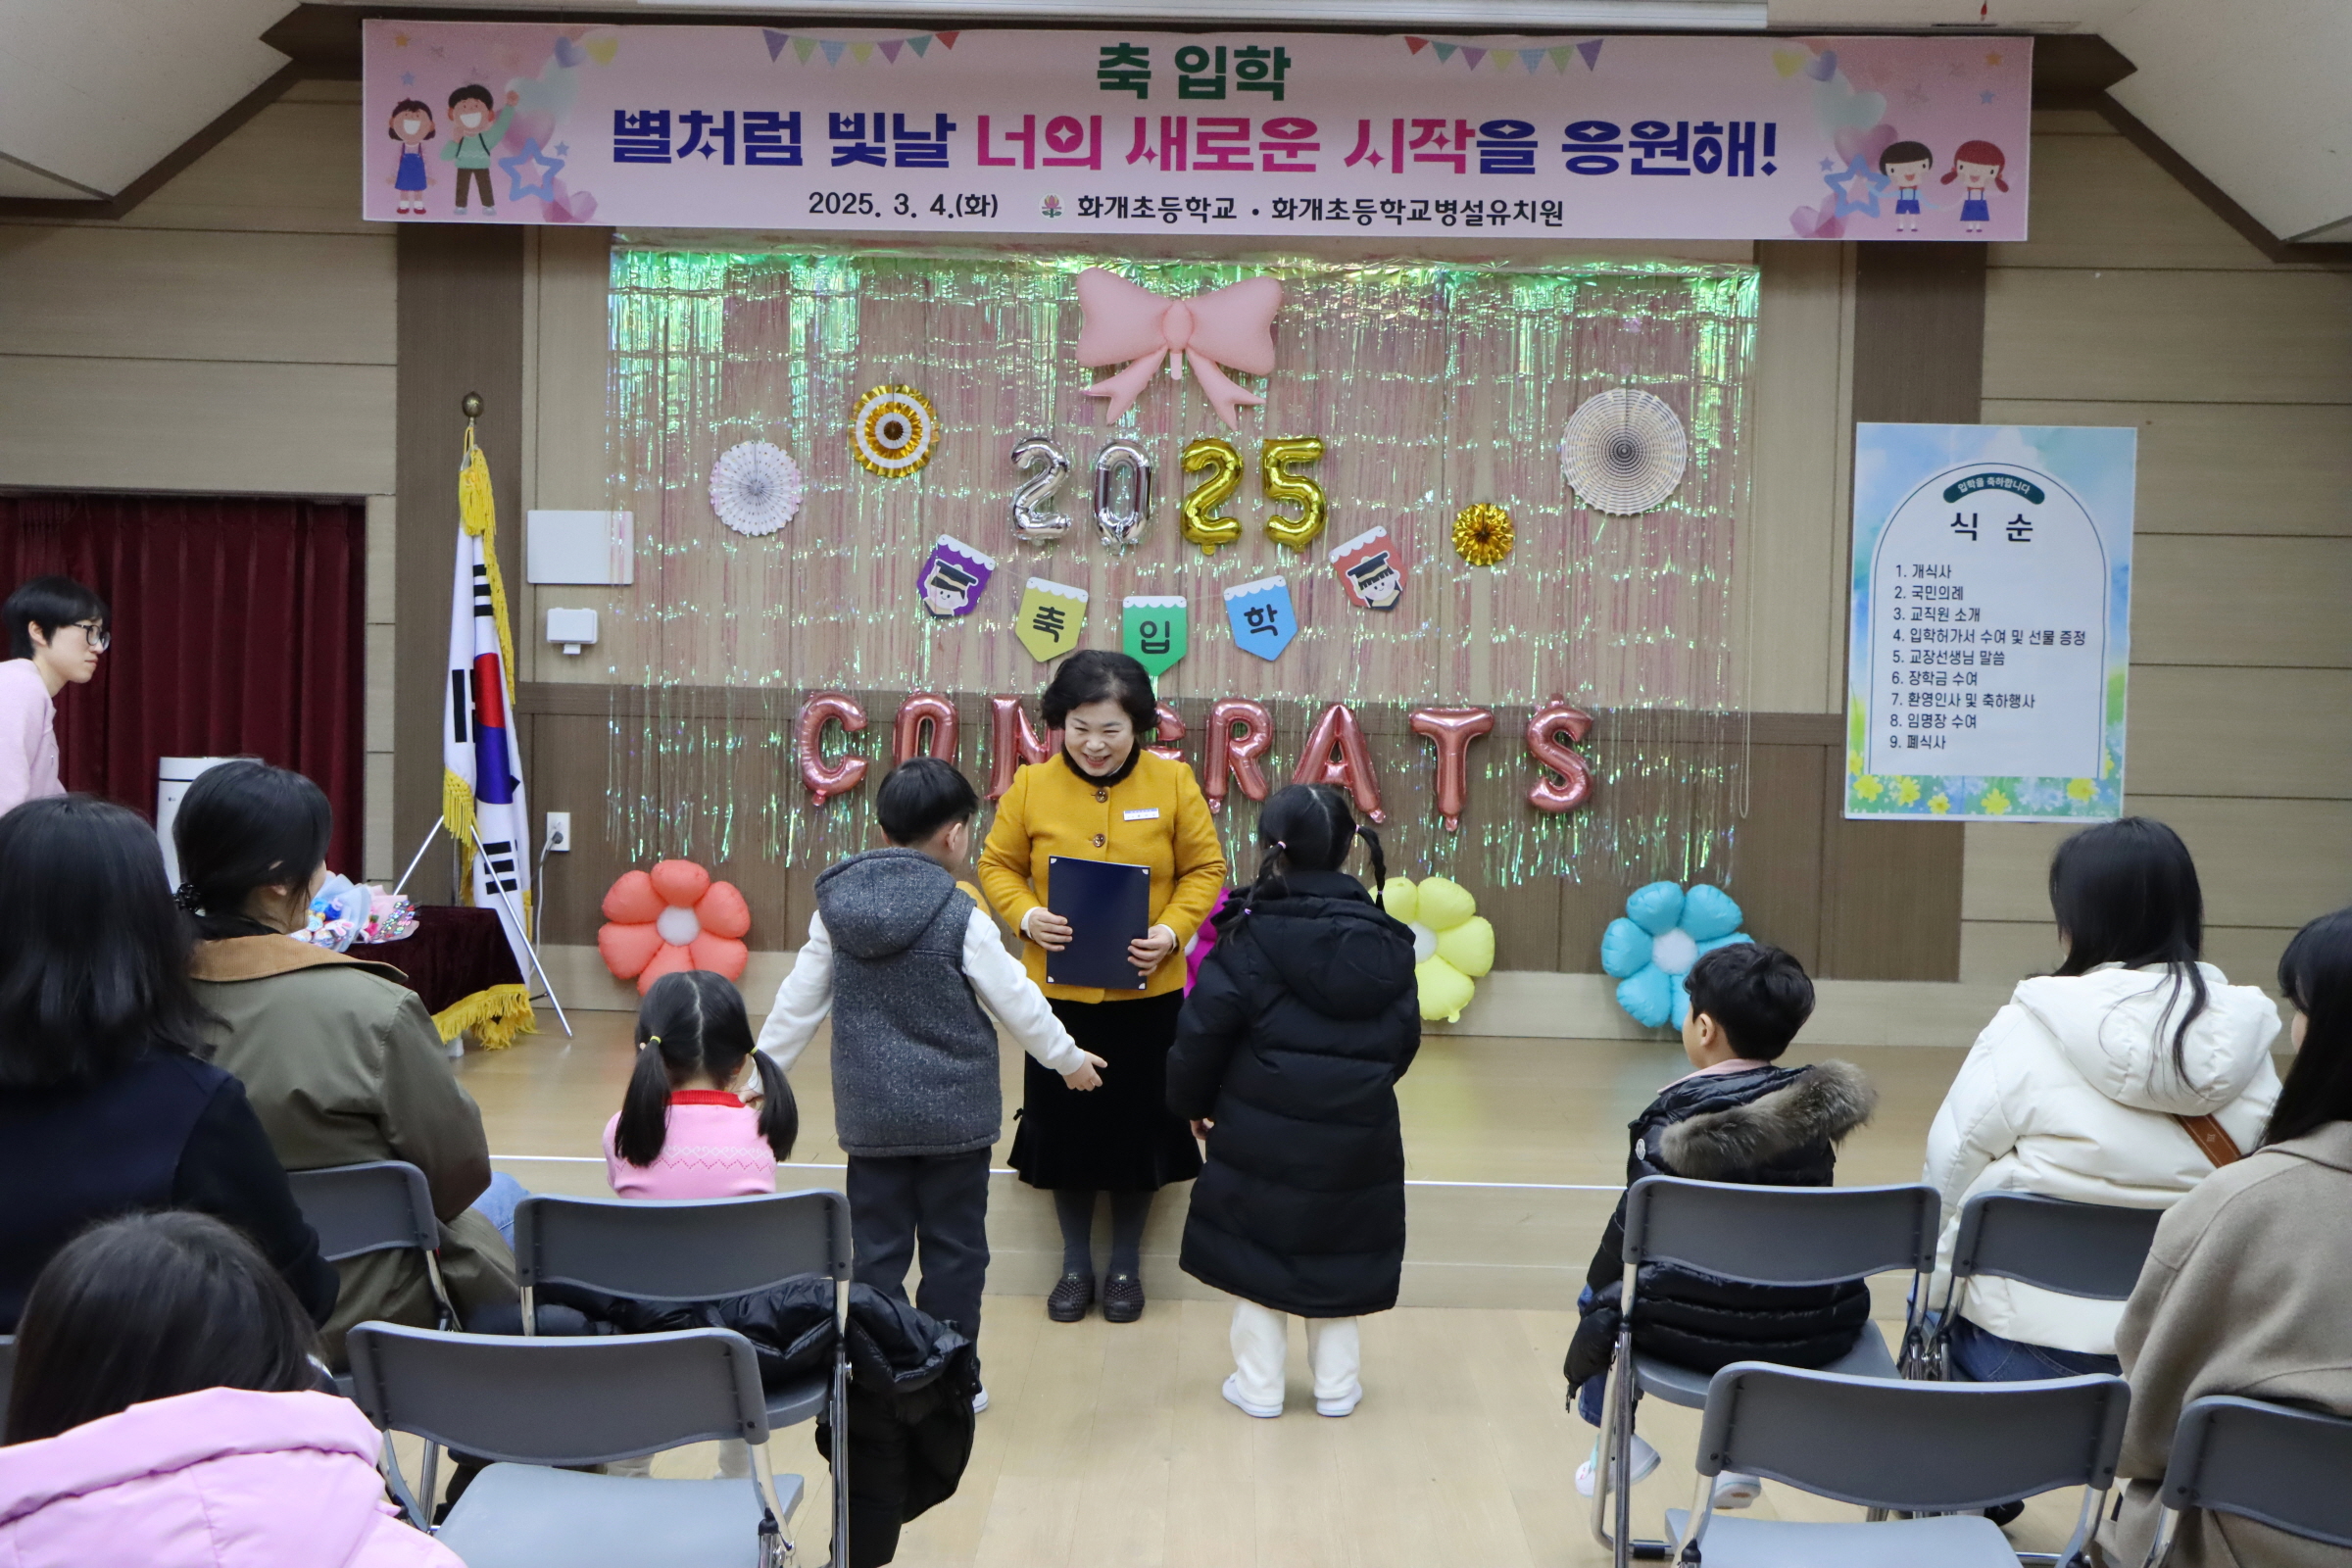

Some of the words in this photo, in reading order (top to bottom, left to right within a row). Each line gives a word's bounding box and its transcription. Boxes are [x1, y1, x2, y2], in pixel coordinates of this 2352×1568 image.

[1097, 42, 1152, 99] 축
[1174, 44, 1291, 101] 입학
[612, 109, 803, 166] 별처럼
[828, 112, 956, 168] 빛날
[977, 113, 1102, 170] 너의
[1125, 115, 1320, 172] 새로운
[1344, 118, 1538, 174] 시작을
[1561, 120, 1777, 176] 응원해!
[808, 191, 881, 218] 2025.
[893, 192, 916, 218] 3.
[929, 193, 998, 219] 4.(화)
[1077, 194, 1237, 223] 화개초등학교
[1271, 197, 1562, 226] 화개초등학교병설유치원
[1958, 477, 1984, 493] 입학을
[1986, 476, 2031, 494] 축하합니다
[1009, 435, 1329, 555] 2025
[1895, 564, 1906, 577] 1.
[1912, 564, 1951, 578] 개식사
[1893, 585, 1905, 599] 2.
[1911, 585, 1963, 600] 국민의례
[1892, 607, 1904, 620] 3.
[1910, 606, 1948, 621] 교직원
[1954, 607, 1980, 621] 소개
[1892, 628, 1904, 641] 4.
[1910, 627, 1975, 643] 입학허가서
[1981, 629, 2005, 644] 수여
[2011, 629, 2023, 644] 및
[2029, 630, 2054, 645] 선물
[2059, 630, 2084, 646] 증정
[1892, 649, 1903, 662] 5.
[1909, 649, 1974, 664] 교장선생님
[1980, 650, 2004, 665] 말씀
[1891, 670, 1903, 684] 6.
[1908, 670, 1946, 686] 장학금
[1952, 671, 1977, 686] 수여
[1890, 692, 1902, 705] 7.
[1907, 691, 1961, 707] 환영인사
[1965, 693, 1976, 708] 및
[1982, 693, 2034, 709] 축하행사
[1889, 713, 1901, 726] 8.
[1907, 712, 1946, 728] 임명장
[1951, 713, 1976, 728] 수여
[1889, 734, 1901, 748] 9.
[1906, 734, 1945, 749] 폐식사
[799, 691, 1593, 821] CONRATS
